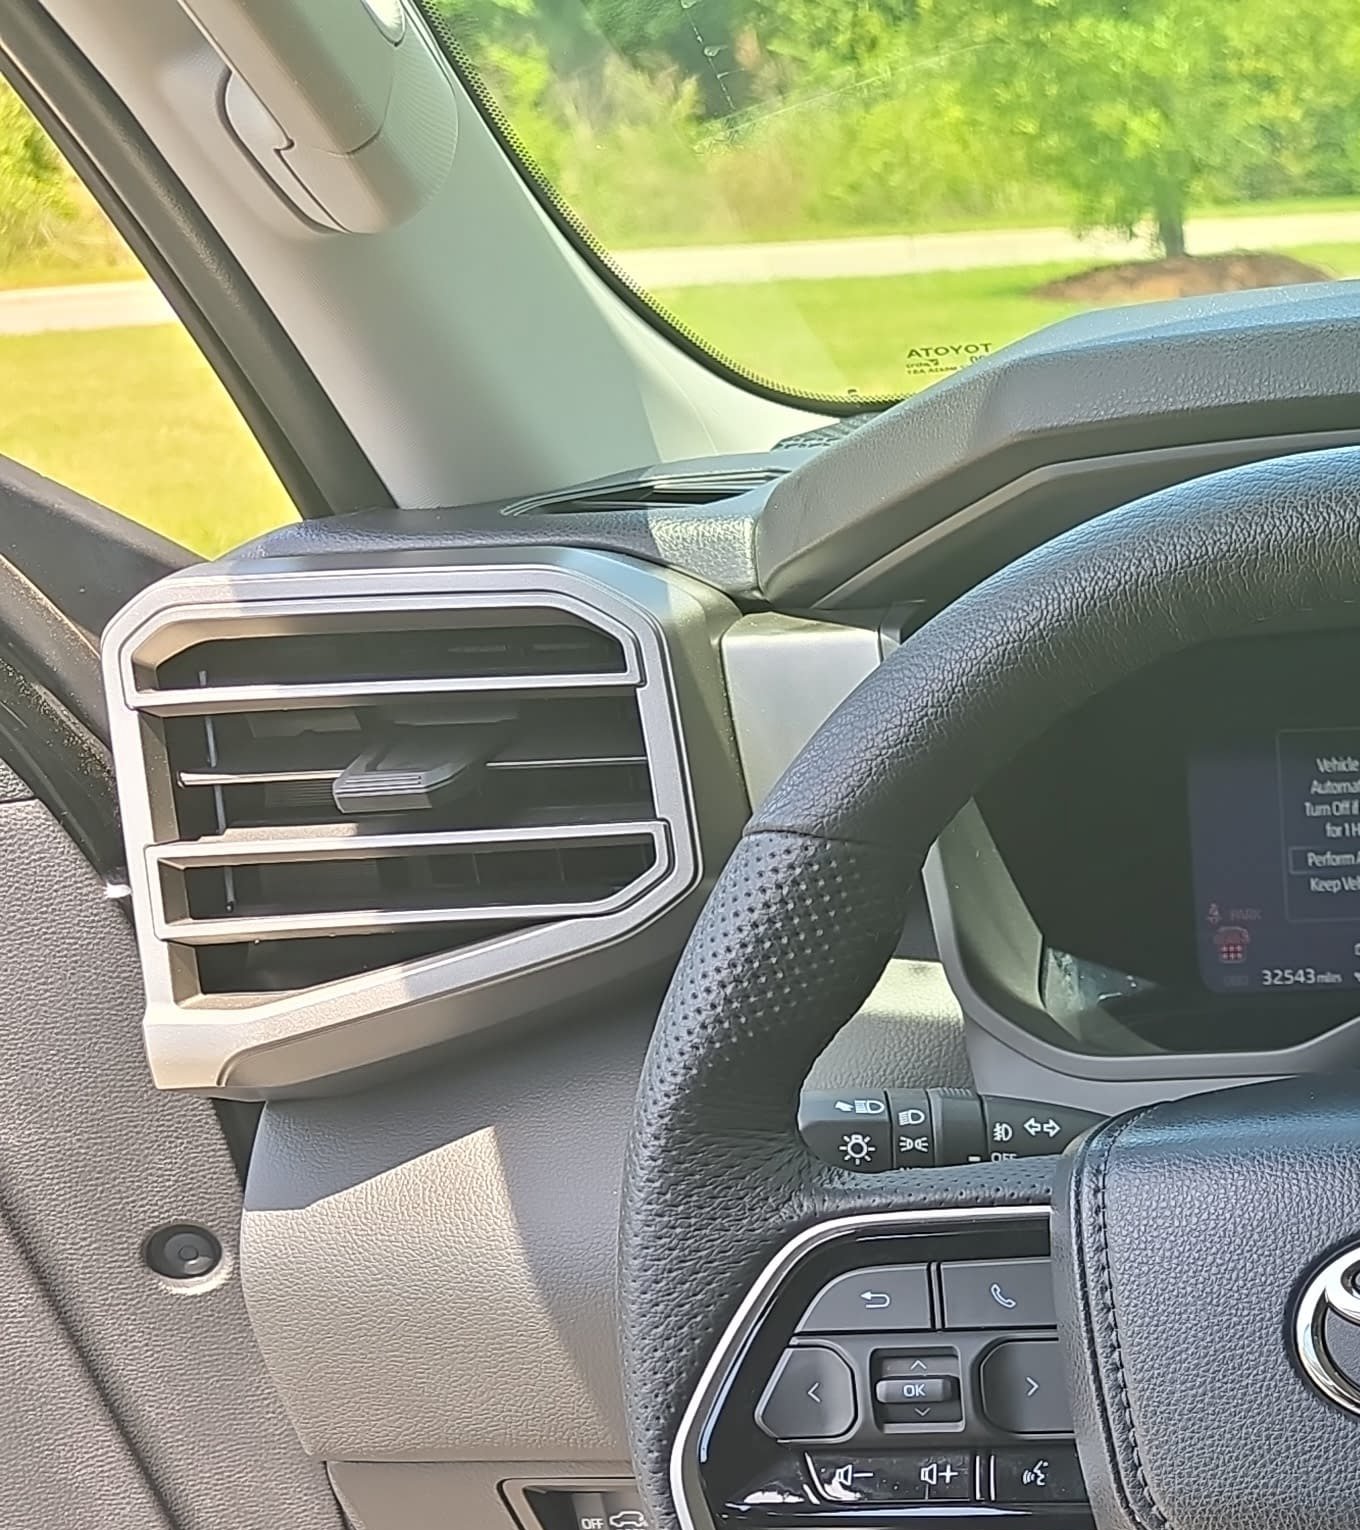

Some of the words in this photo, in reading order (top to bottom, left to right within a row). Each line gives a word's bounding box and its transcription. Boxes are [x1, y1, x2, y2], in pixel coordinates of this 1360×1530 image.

[1316, 757, 1359, 772] Vehicle
[1304, 801, 1331, 816] Turn
[1332, 800, 1350, 815] Off
[1351, 799, 1359, 814] if
[1325, 822, 1342, 837] for
[1307, 851, 1355, 867] Perform
[1310, 877, 1341, 893] Keep
[1262, 969, 1315, 985] 32543
[903, 1384, 926, 1397] OK
[581, 1518, 604, 1530] OFF
